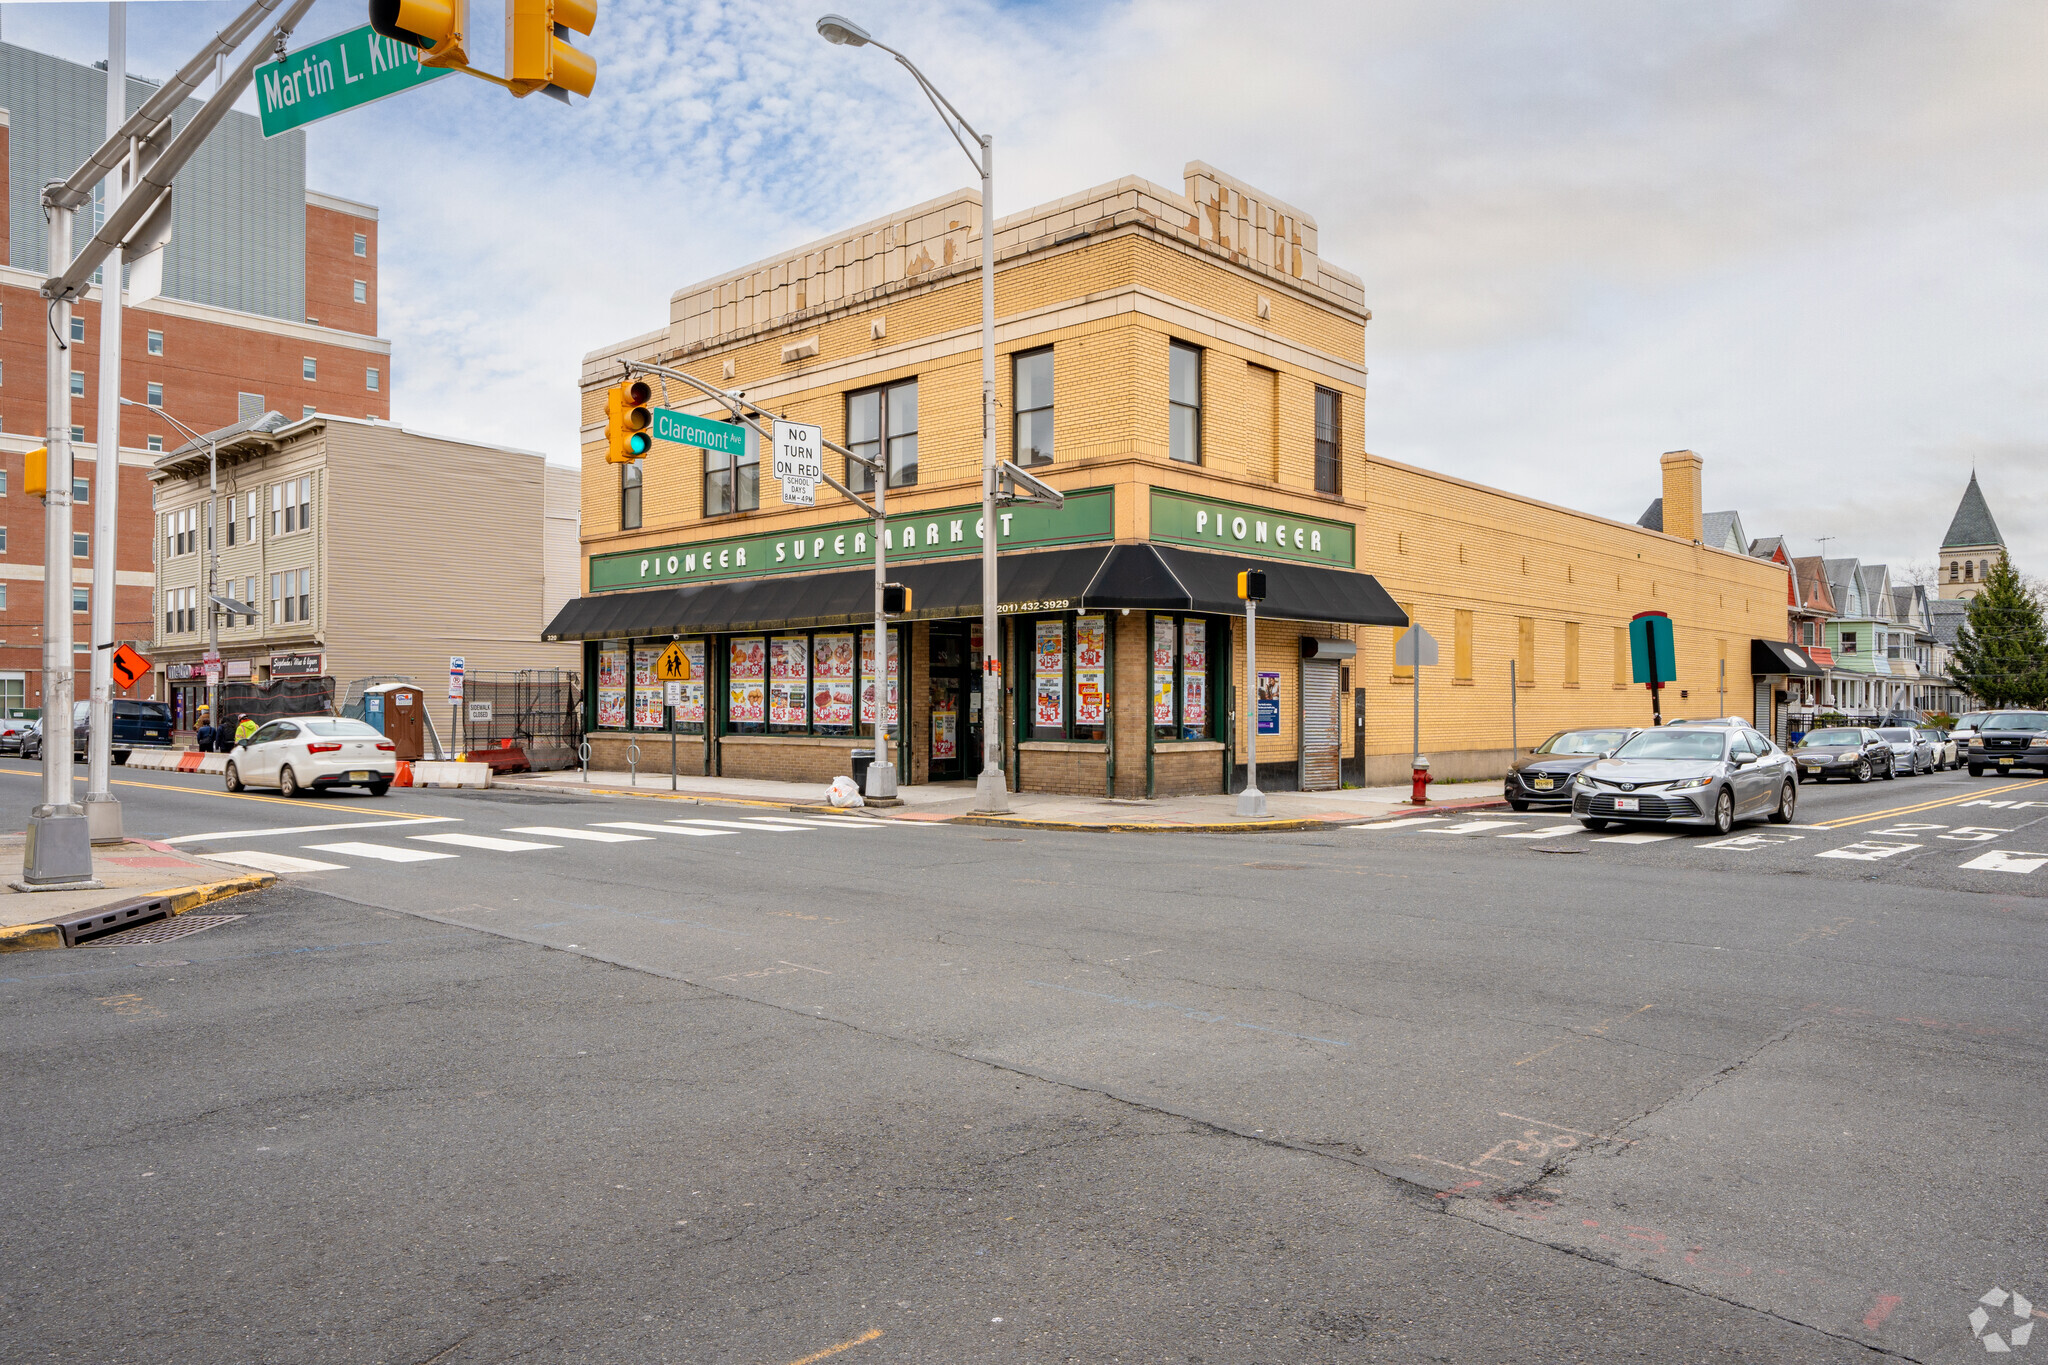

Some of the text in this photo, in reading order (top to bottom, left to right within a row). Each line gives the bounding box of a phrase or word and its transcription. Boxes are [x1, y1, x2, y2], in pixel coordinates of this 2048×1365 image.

[263, 33, 422, 113] Martin L. King
[659, 416, 742, 450] Claremont Ave
[789, 428, 807, 442] NO
[783, 444, 813, 459] TURN
[776, 461, 819, 477] ON RED
[787, 477, 810, 487] SCHOOL
[791, 485, 806, 494] DAYS
[1196, 510, 1321, 552] PIONEER
[640, 547, 747, 578] PIONEER
[1020, 600, 1070, 611] 432-3929
[168, 662, 191, 679] metro
